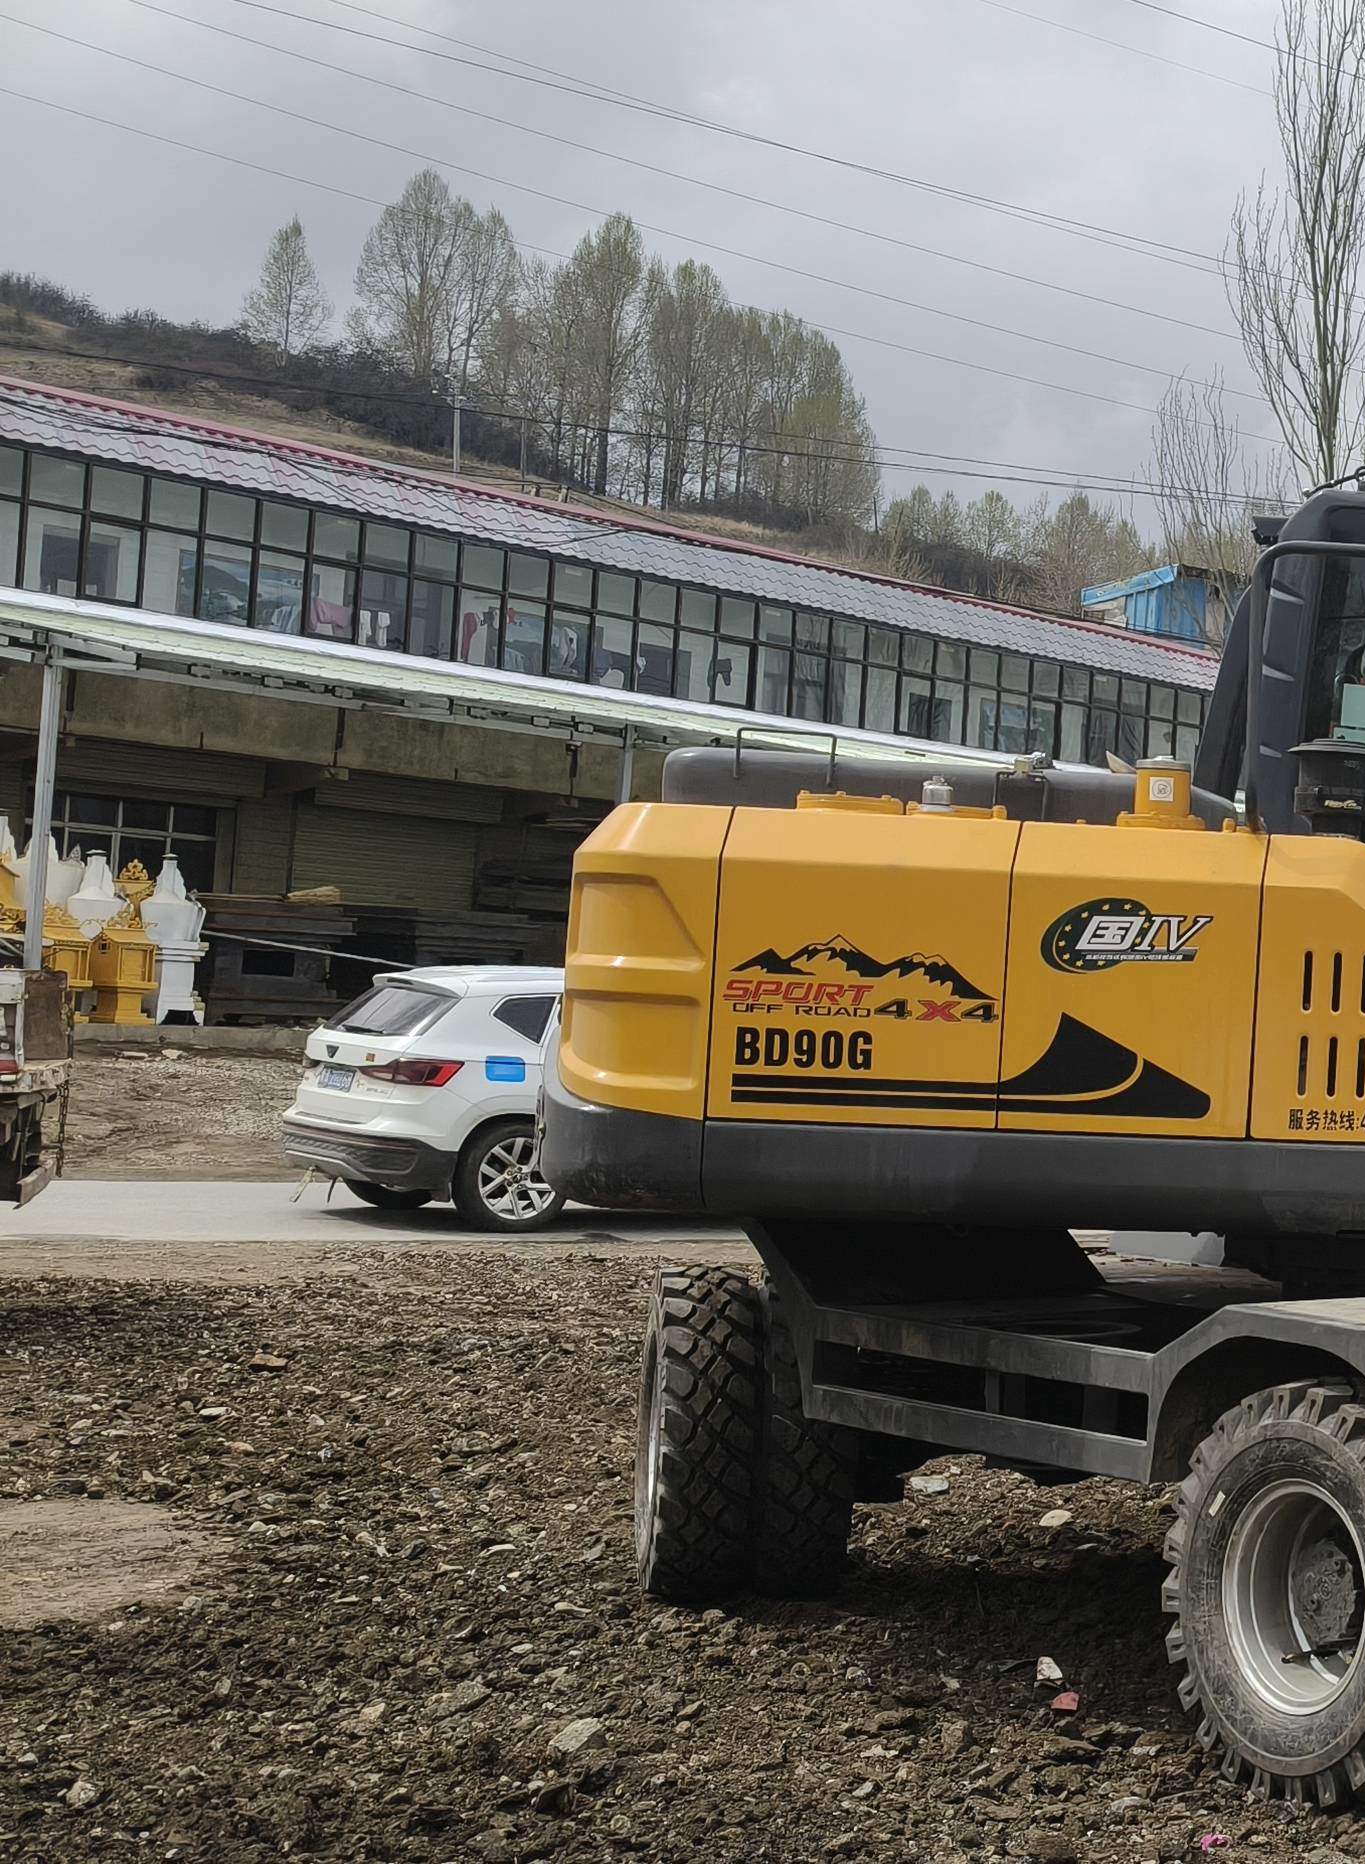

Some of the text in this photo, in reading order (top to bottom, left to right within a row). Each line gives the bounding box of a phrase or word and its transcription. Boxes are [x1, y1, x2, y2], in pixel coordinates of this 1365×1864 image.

[723, 979, 875, 1005] SPORT
[732, 1002, 784, 1014] OFF
[795, 1005, 871, 1018] ROAD
[735, 1026, 873, 1071] BD90G
